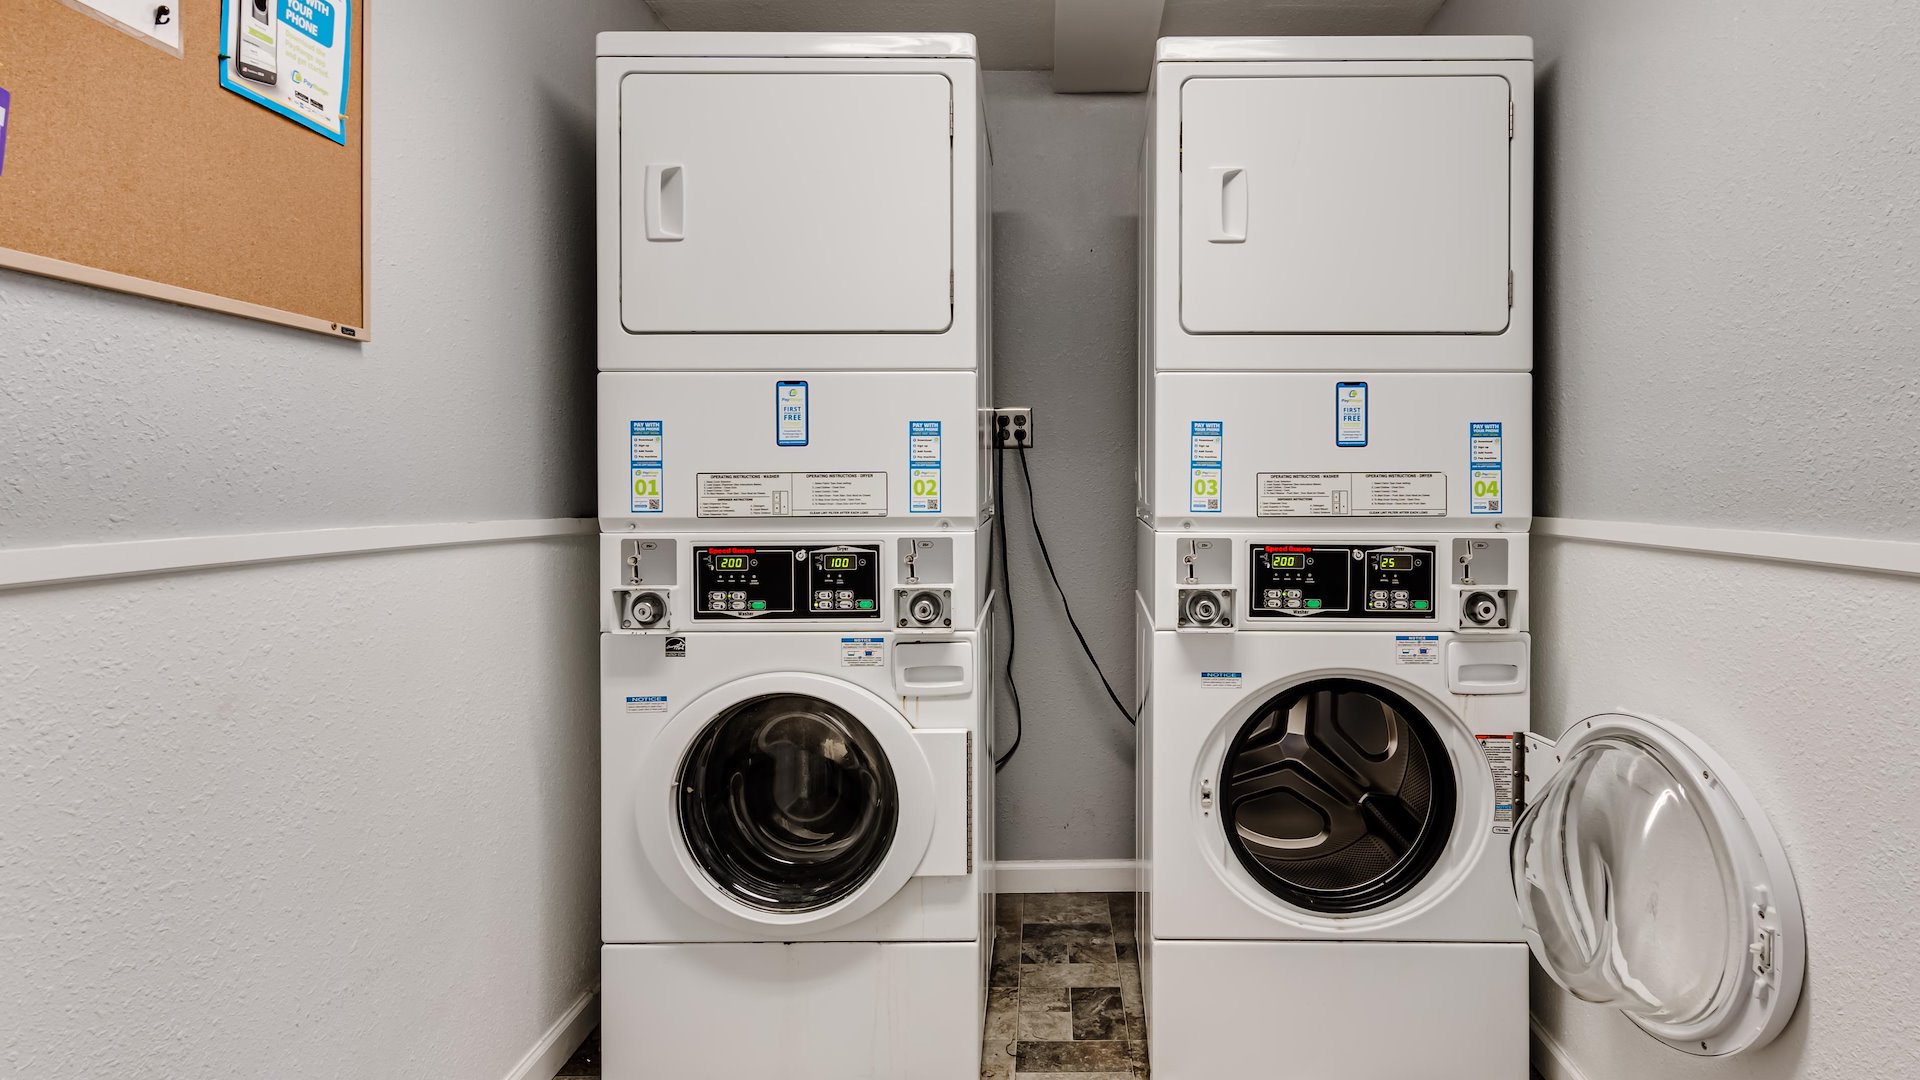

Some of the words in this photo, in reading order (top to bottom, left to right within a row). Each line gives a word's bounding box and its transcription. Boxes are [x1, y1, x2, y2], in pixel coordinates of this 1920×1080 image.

[287, 0, 313, 20] YOUR
[285, 8, 319, 37] PHONE
[634, 479, 659, 496] 01
[913, 479, 938, 496] 02
[1194, 479, 1218, 496] 03
[1474, 480, 1499, 498] 04
[720, 558, 743, 568] 200
[831, 558, 850, 568] 100
[1273, 556, 1295, 566] 200
[1381, 558, 1395, 568] 25
